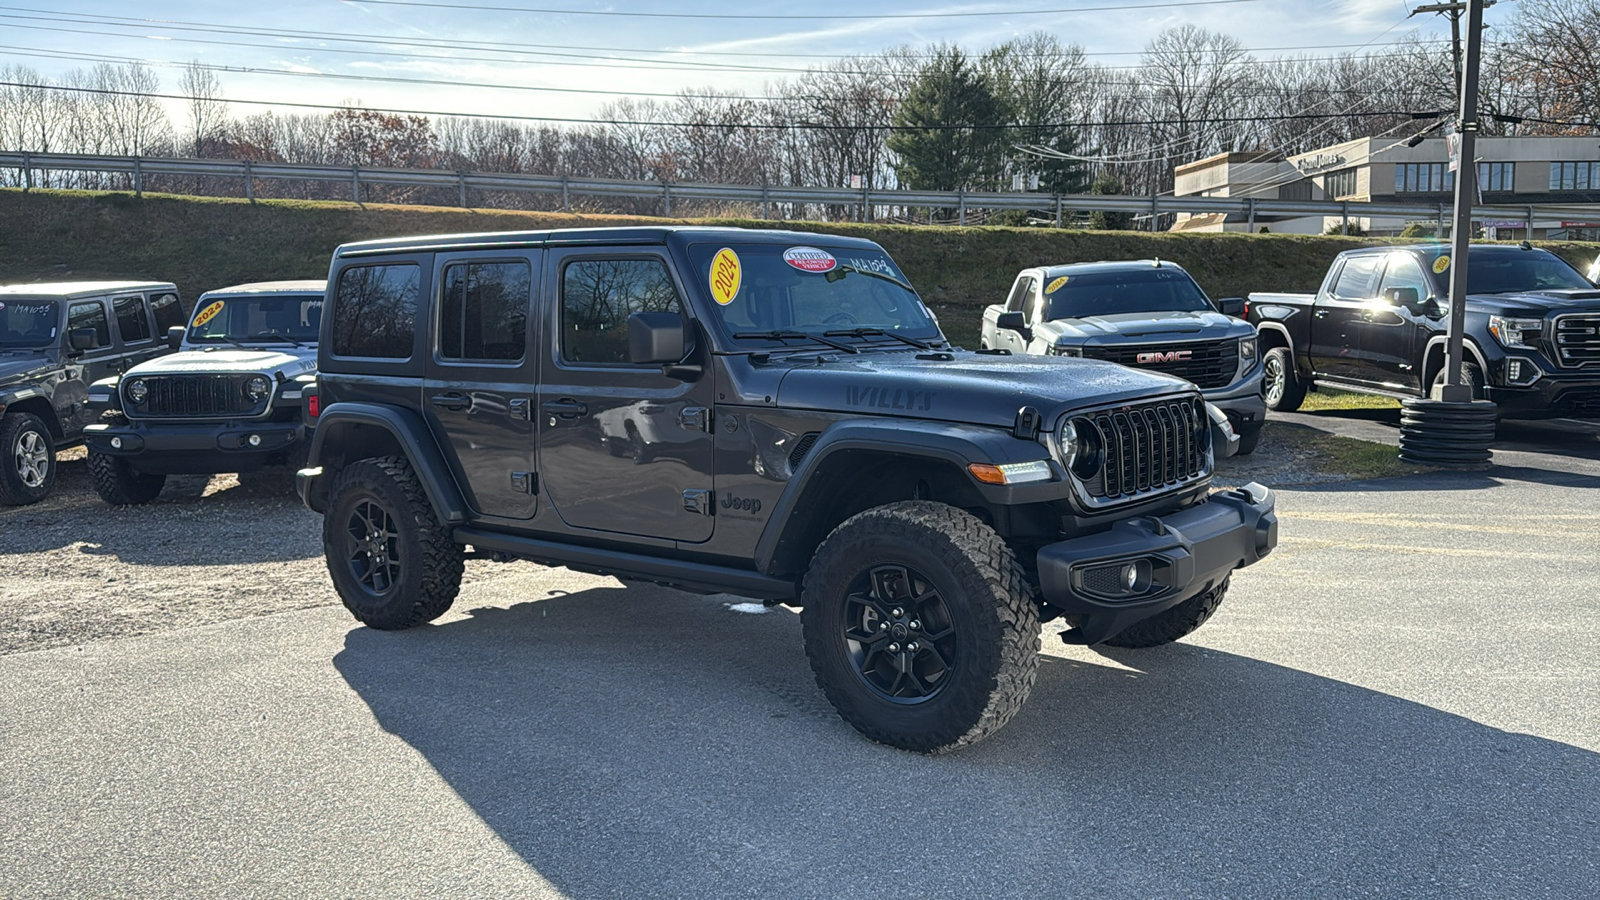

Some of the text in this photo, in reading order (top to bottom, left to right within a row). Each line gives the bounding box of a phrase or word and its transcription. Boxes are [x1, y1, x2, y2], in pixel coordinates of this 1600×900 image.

[715, 253, 737, 298] 2024
[196, 302, 222, 325] 2024
[1136, 350, 1193, 363] GMC
[846, 384, 937, 411] WILLYS
[720, 491, 762, 515] Jeep
